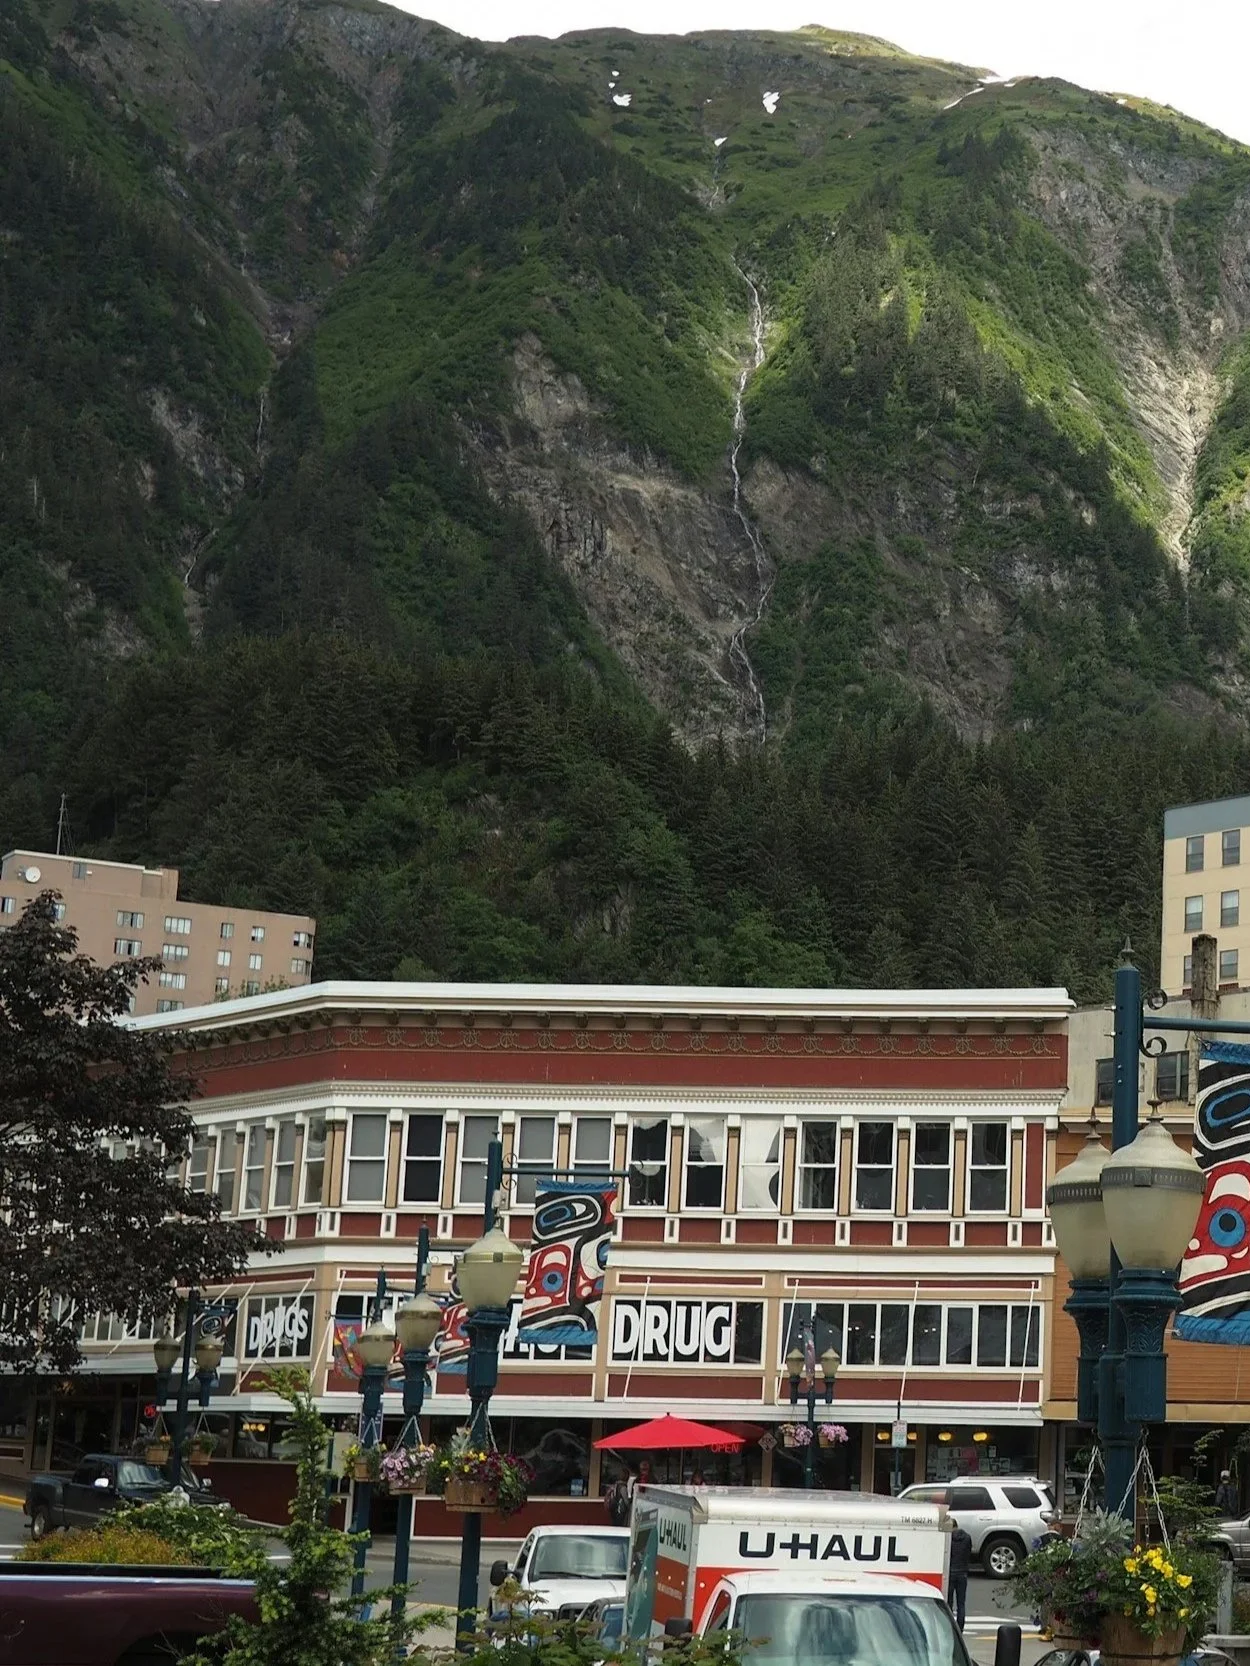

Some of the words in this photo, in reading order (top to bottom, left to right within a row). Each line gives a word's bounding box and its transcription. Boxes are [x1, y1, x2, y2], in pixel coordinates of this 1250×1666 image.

[249, 1306, 308, 1350] DRUGS
[612, 1304, 732, 1356] DRUG
[711, 1443, 739, 1453] OPEN
[659, 1517, 687, 1552] U-HAUL
[738, 1531, 909, 1563] U-HAUL
